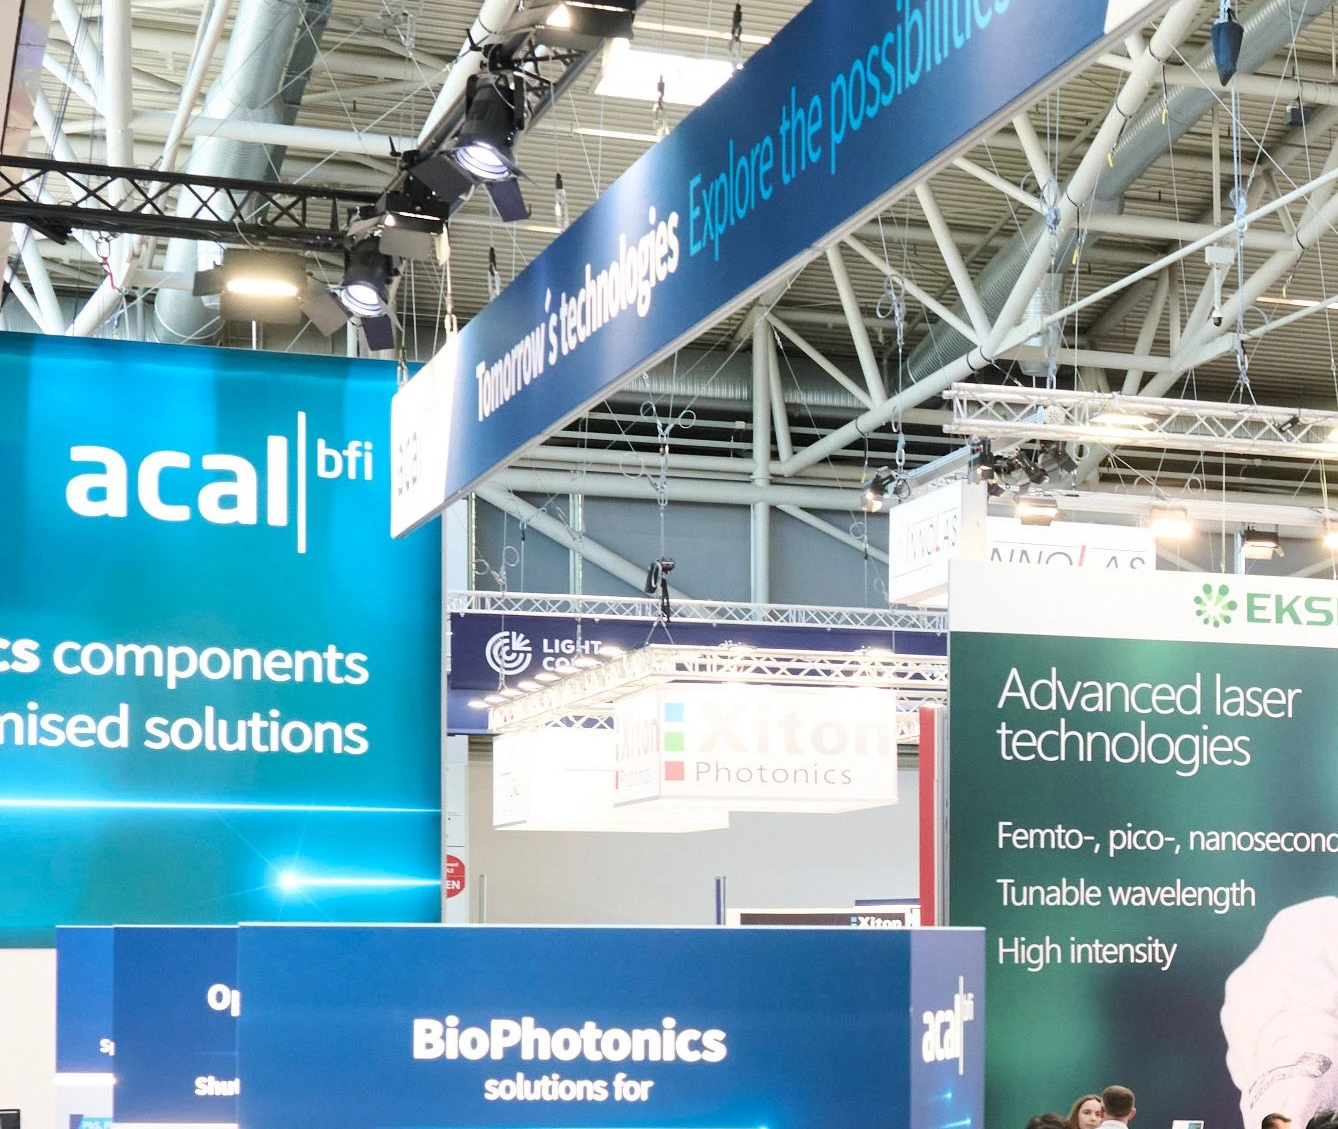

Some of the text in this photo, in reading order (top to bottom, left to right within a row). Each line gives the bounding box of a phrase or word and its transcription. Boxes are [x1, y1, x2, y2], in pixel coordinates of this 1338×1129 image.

[559, 85, 822, 357] technologies Explore the
[66, 435, 288, 526] acal
[316, 439, 374, 481] bfi
[53, 640, 369, 689] components
[997, 667, 1302, 718] Advanced laser
[144, 706, 369, 755] solutions
[696, 701, 891, 757] Xiton
[997, 718, 1251, 777] technologies
[696, 761, 852, 785] Photonics
[997, 822, 1101, 853] Femto-,
[1109, 824, 1180, 857] pico-,
[997, 878, 1256, 914] Tunable wavelength
[998, 937, 1178, 972] High intensity
[411, 1016, 728, 1067] BioPhotonics
[922, 993, 960, 1064] acal
[484, 1072, 653, 1103] solutions for
